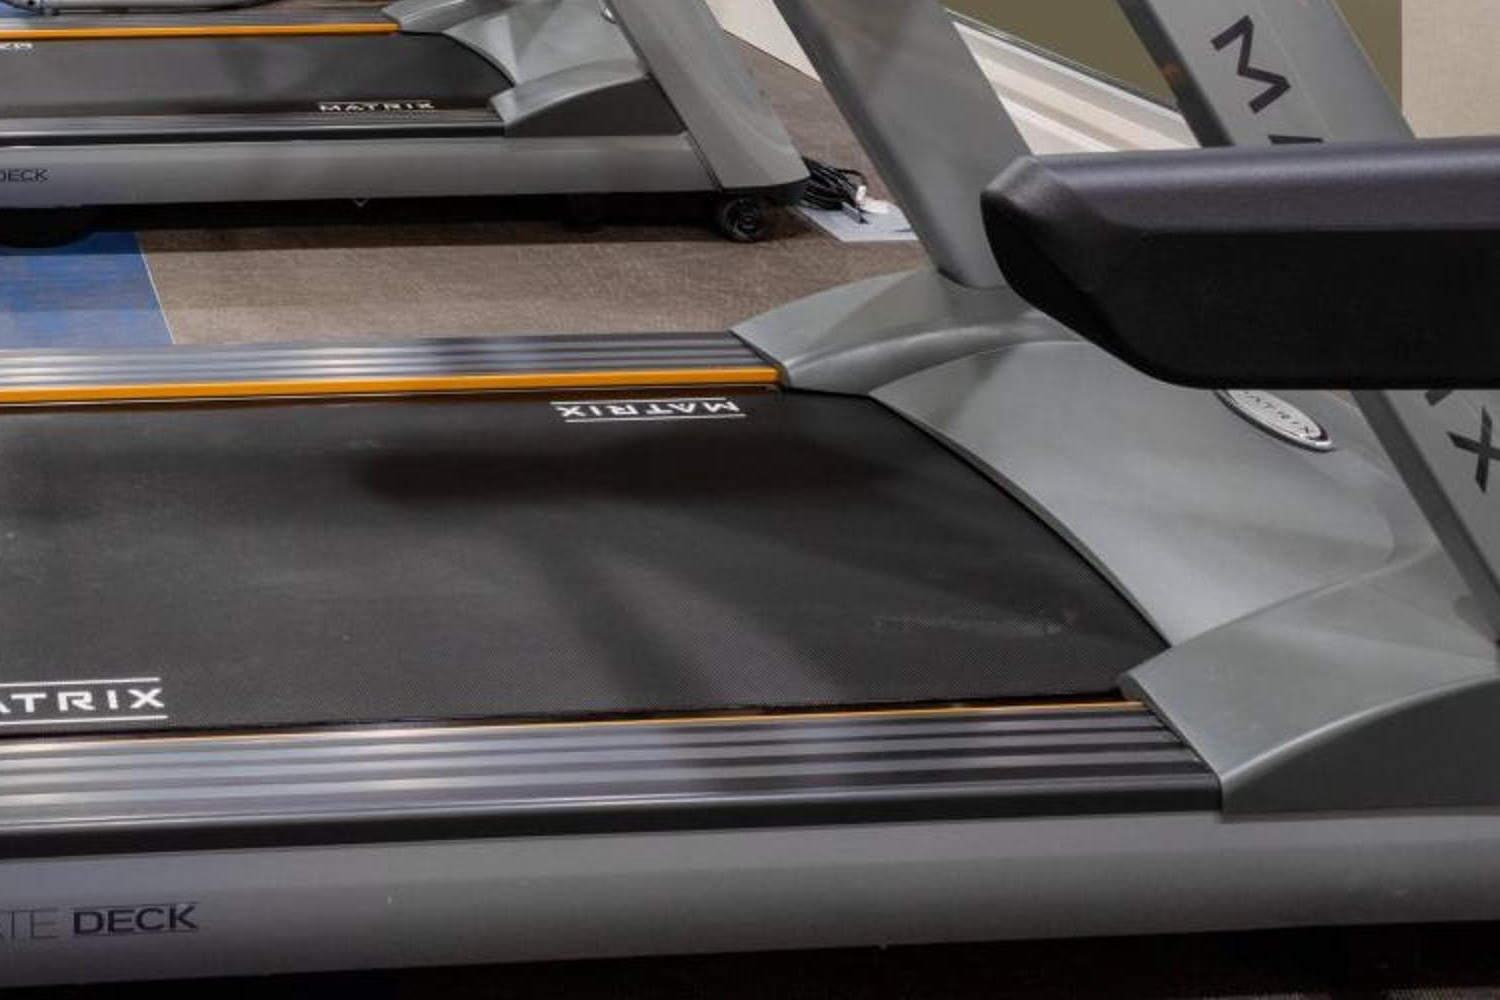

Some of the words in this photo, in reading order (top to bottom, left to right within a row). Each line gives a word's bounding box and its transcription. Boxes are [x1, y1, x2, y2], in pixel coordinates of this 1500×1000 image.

[319, 102, 436, 112] MATRIX
[555, 401, 740, 417] MATRIX
[72, 904, 198, 936] DECK
